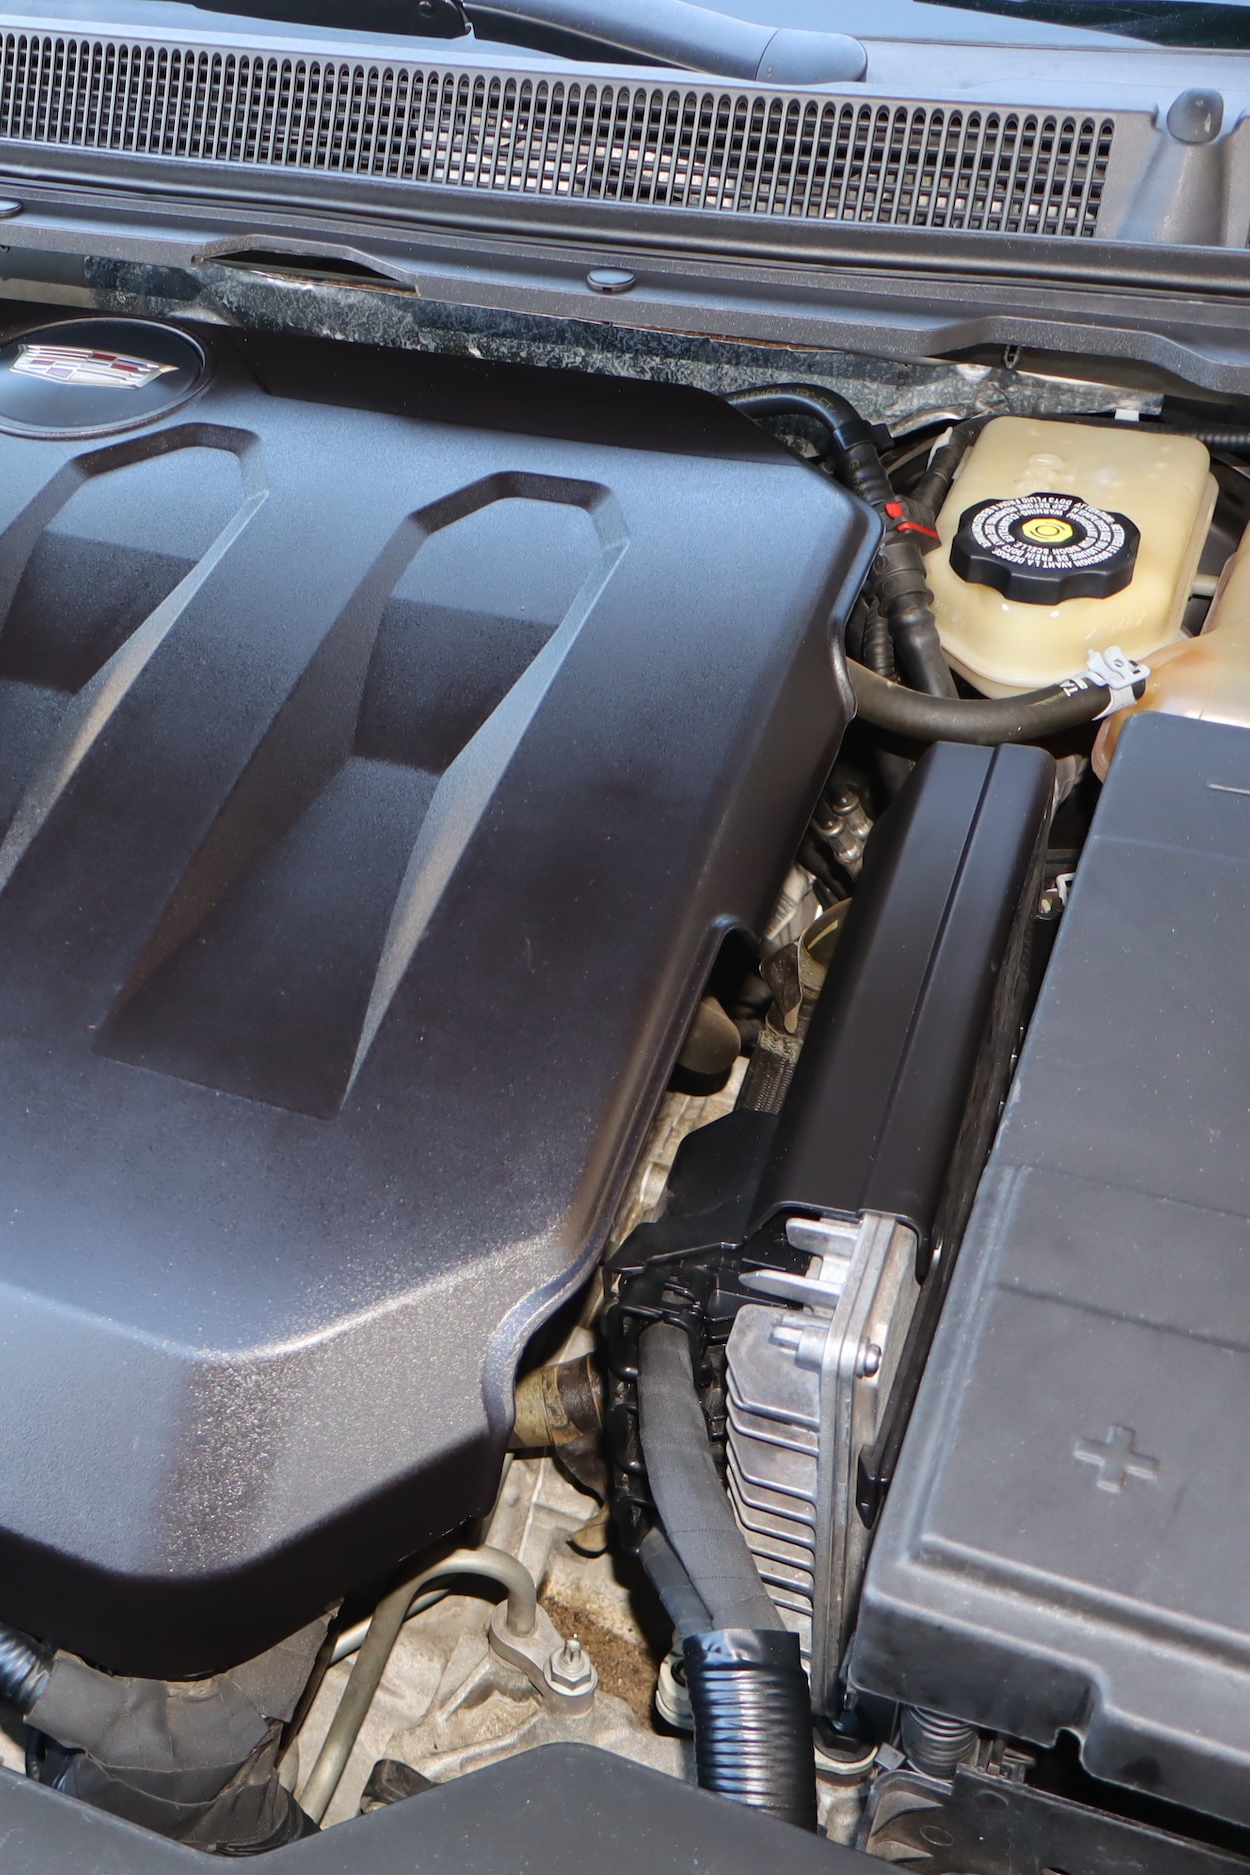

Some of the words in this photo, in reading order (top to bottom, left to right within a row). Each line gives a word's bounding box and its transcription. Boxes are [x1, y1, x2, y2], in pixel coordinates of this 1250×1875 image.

[1021, 496, 1047, 505] FLUID
[1017, 502, 1050, 511] BEFORE
[1052, 502, 1070, 511] CAP
[1024, 551, 1054, 562] FREIN
[1055, 554, 1071, 562] DE
[1076, 550, 1114, 568] BOUCHON
[1027, 559, 1041, 568] LA
[1042, 561, 1073, 569] AVANT
